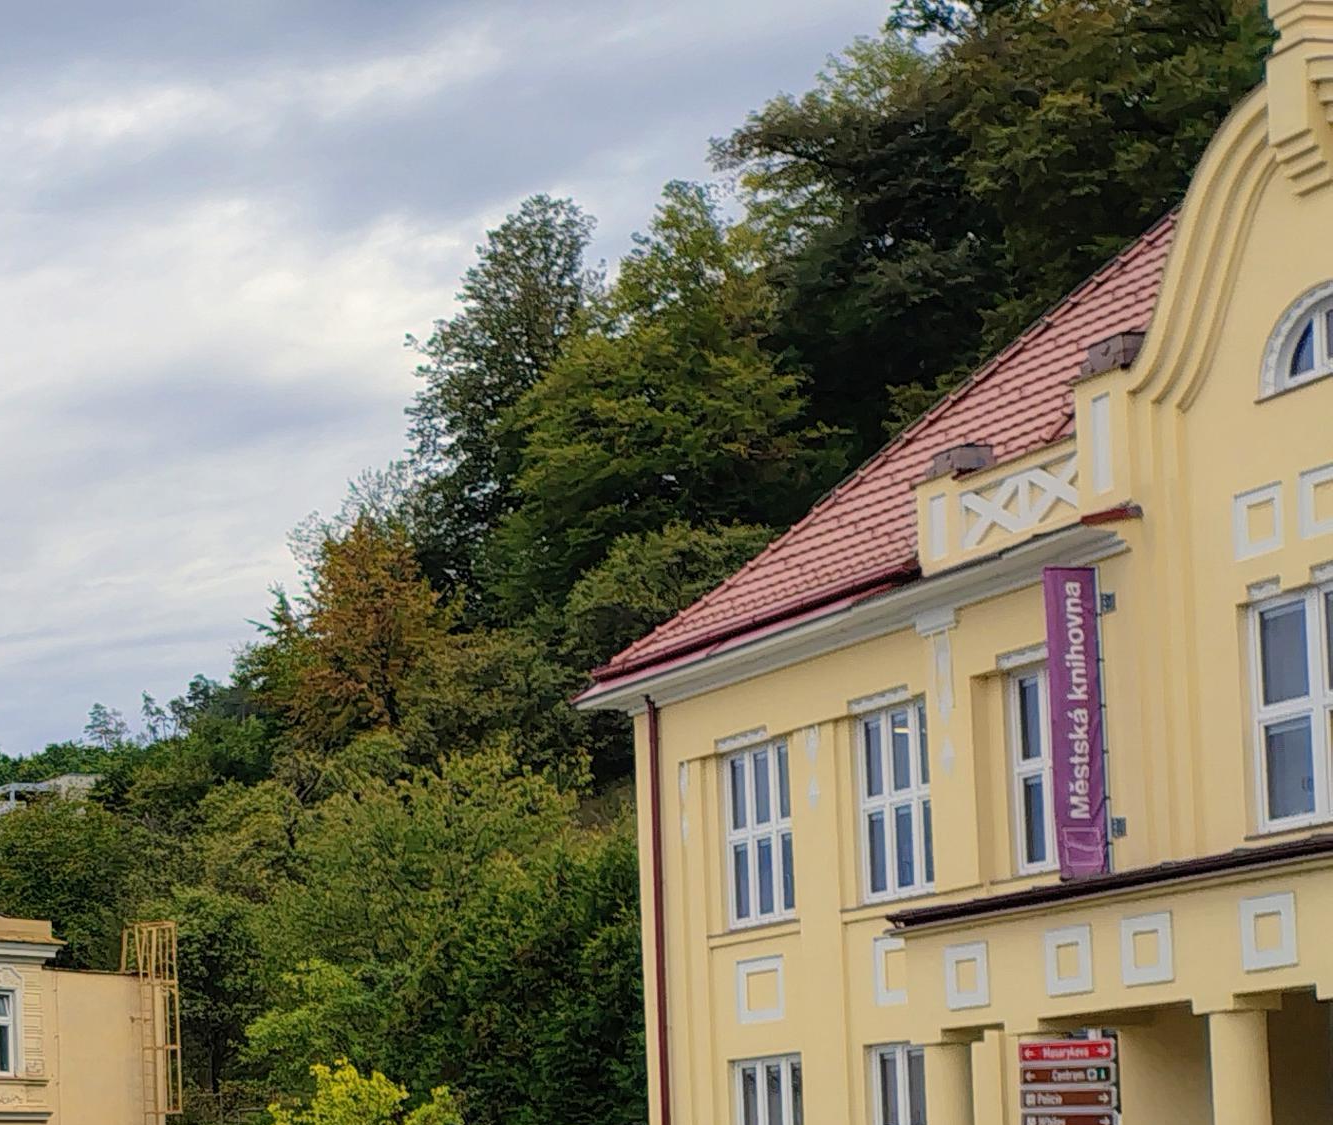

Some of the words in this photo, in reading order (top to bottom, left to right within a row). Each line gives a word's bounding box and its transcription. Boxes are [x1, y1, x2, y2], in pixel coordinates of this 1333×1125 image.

[1064, 580, 1089, 701] knihovna
[1069, 708, 1091, 820] Městská
[1051, 1070, 1086, 1082] Centrum
